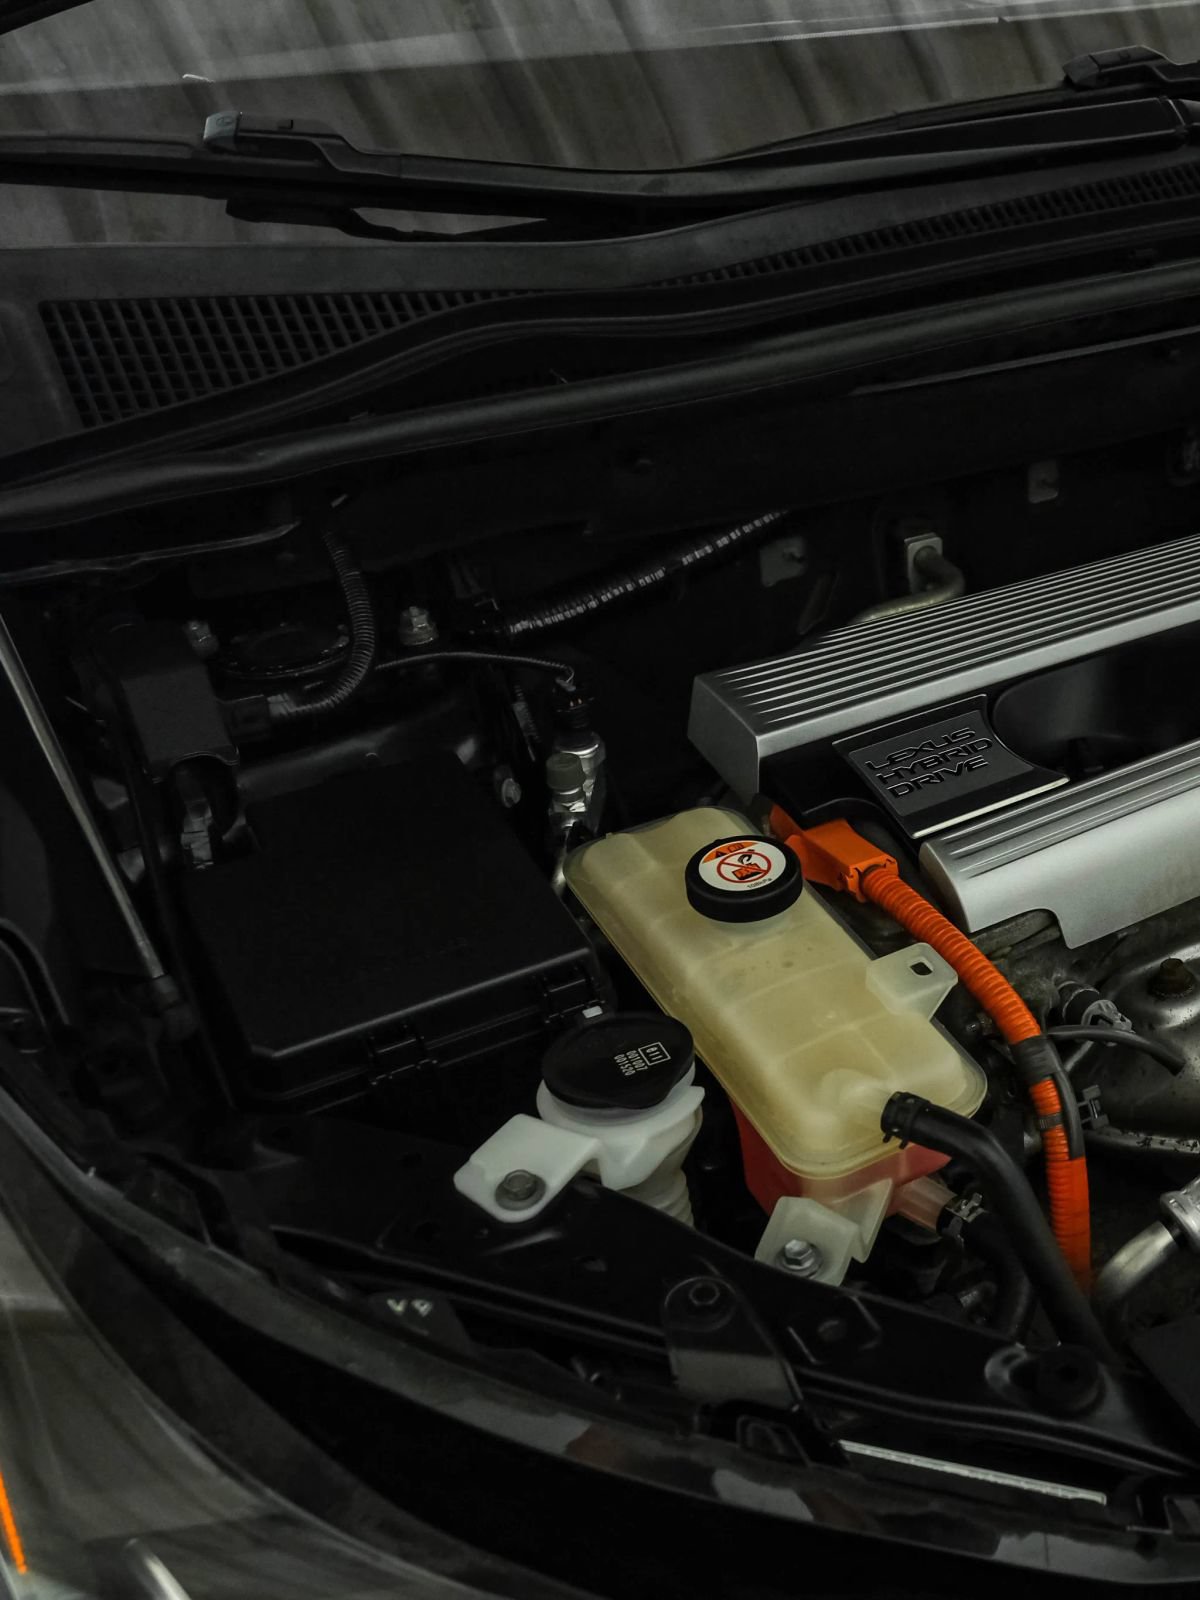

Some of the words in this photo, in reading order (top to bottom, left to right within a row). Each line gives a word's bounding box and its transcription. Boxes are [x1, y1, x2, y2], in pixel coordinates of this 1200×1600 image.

[865, 727, 976, 771] LEXUS
[875, 737, 993, 784] HYBRID
[886, 754, 989, 798] DRIVE
